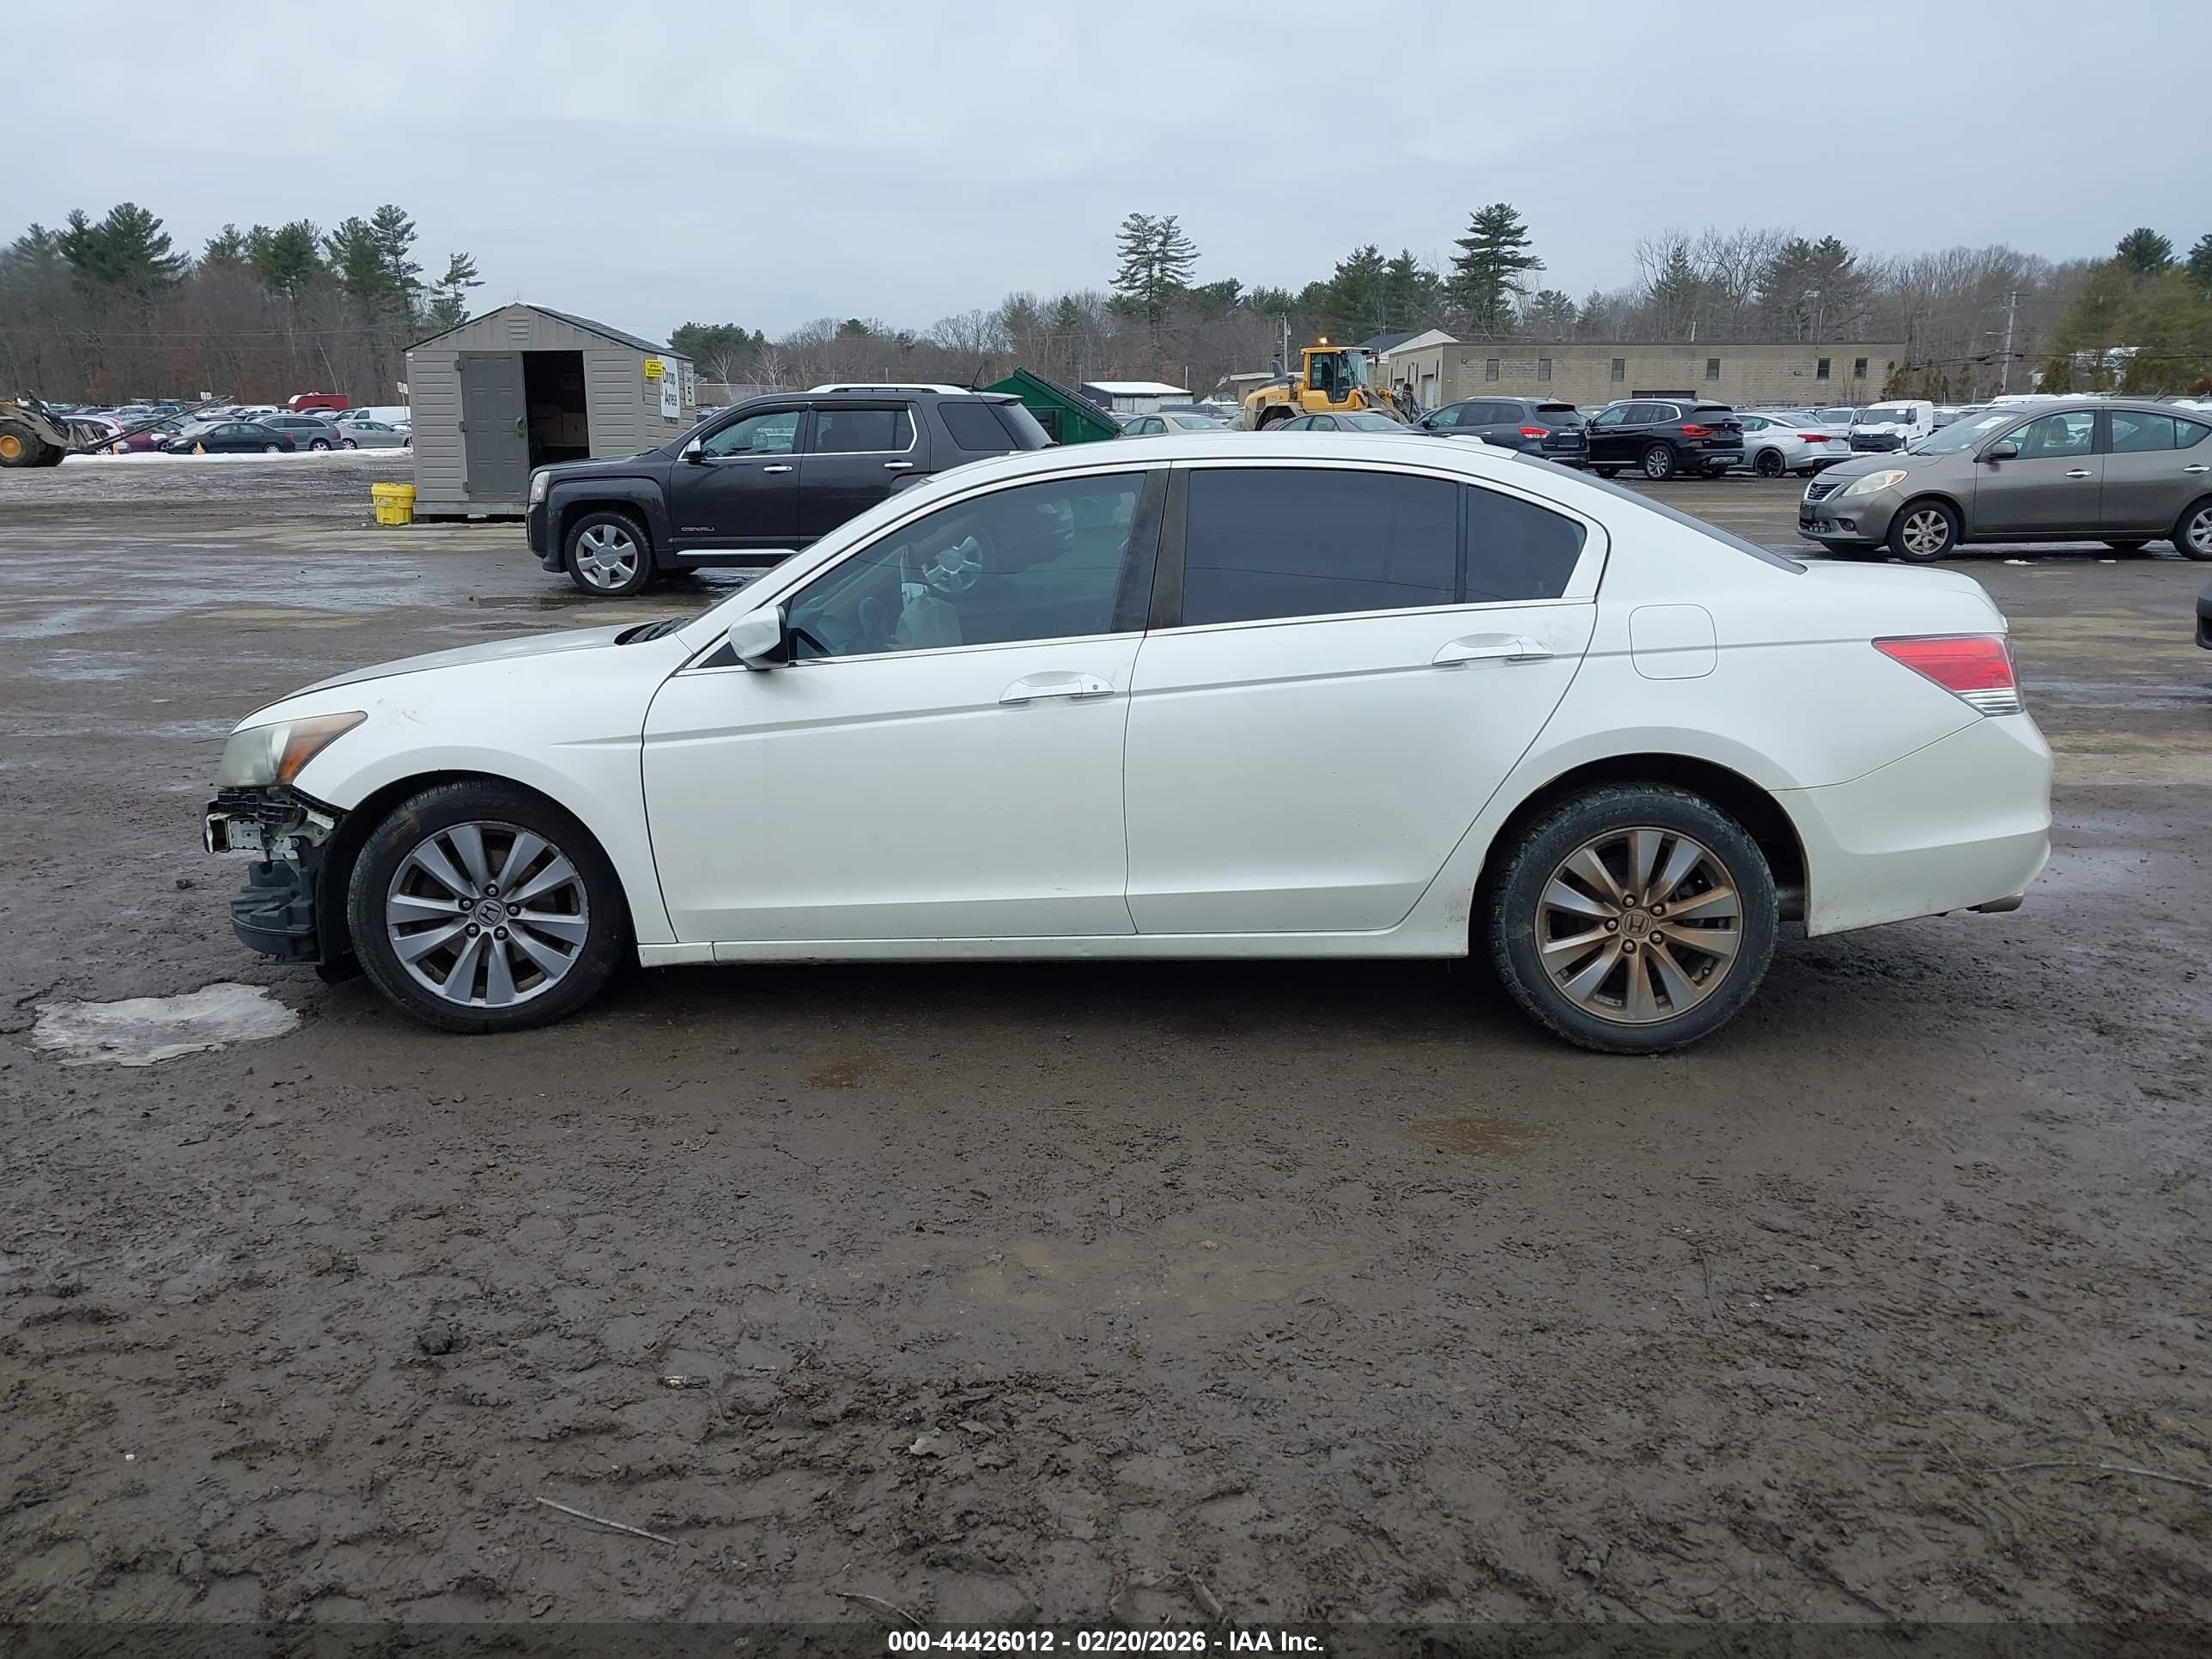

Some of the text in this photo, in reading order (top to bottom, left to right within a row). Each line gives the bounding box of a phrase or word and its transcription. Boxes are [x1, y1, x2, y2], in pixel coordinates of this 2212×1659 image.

[662, 367, 676, 389] Drop
[665, 388, 678, 407] Area
[687, 386, 693, 402] 5
